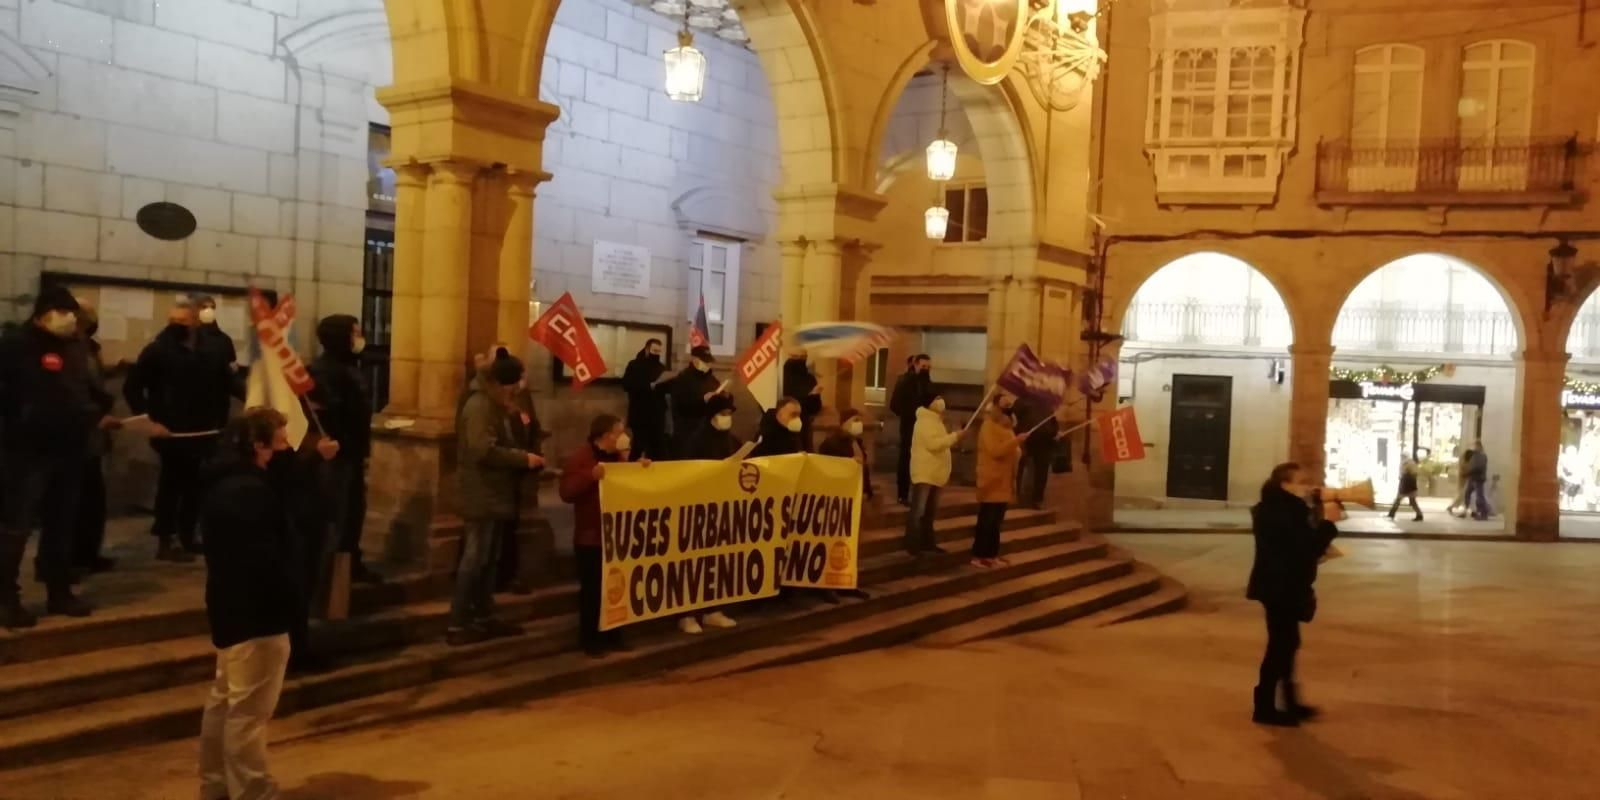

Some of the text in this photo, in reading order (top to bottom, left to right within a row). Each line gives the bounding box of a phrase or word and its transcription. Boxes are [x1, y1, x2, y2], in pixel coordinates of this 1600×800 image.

[602, 507, 672, 563] BUSES
[677, 496, 775, 552] URBANOS
[630, 549, 765, 617] CONVENIO
